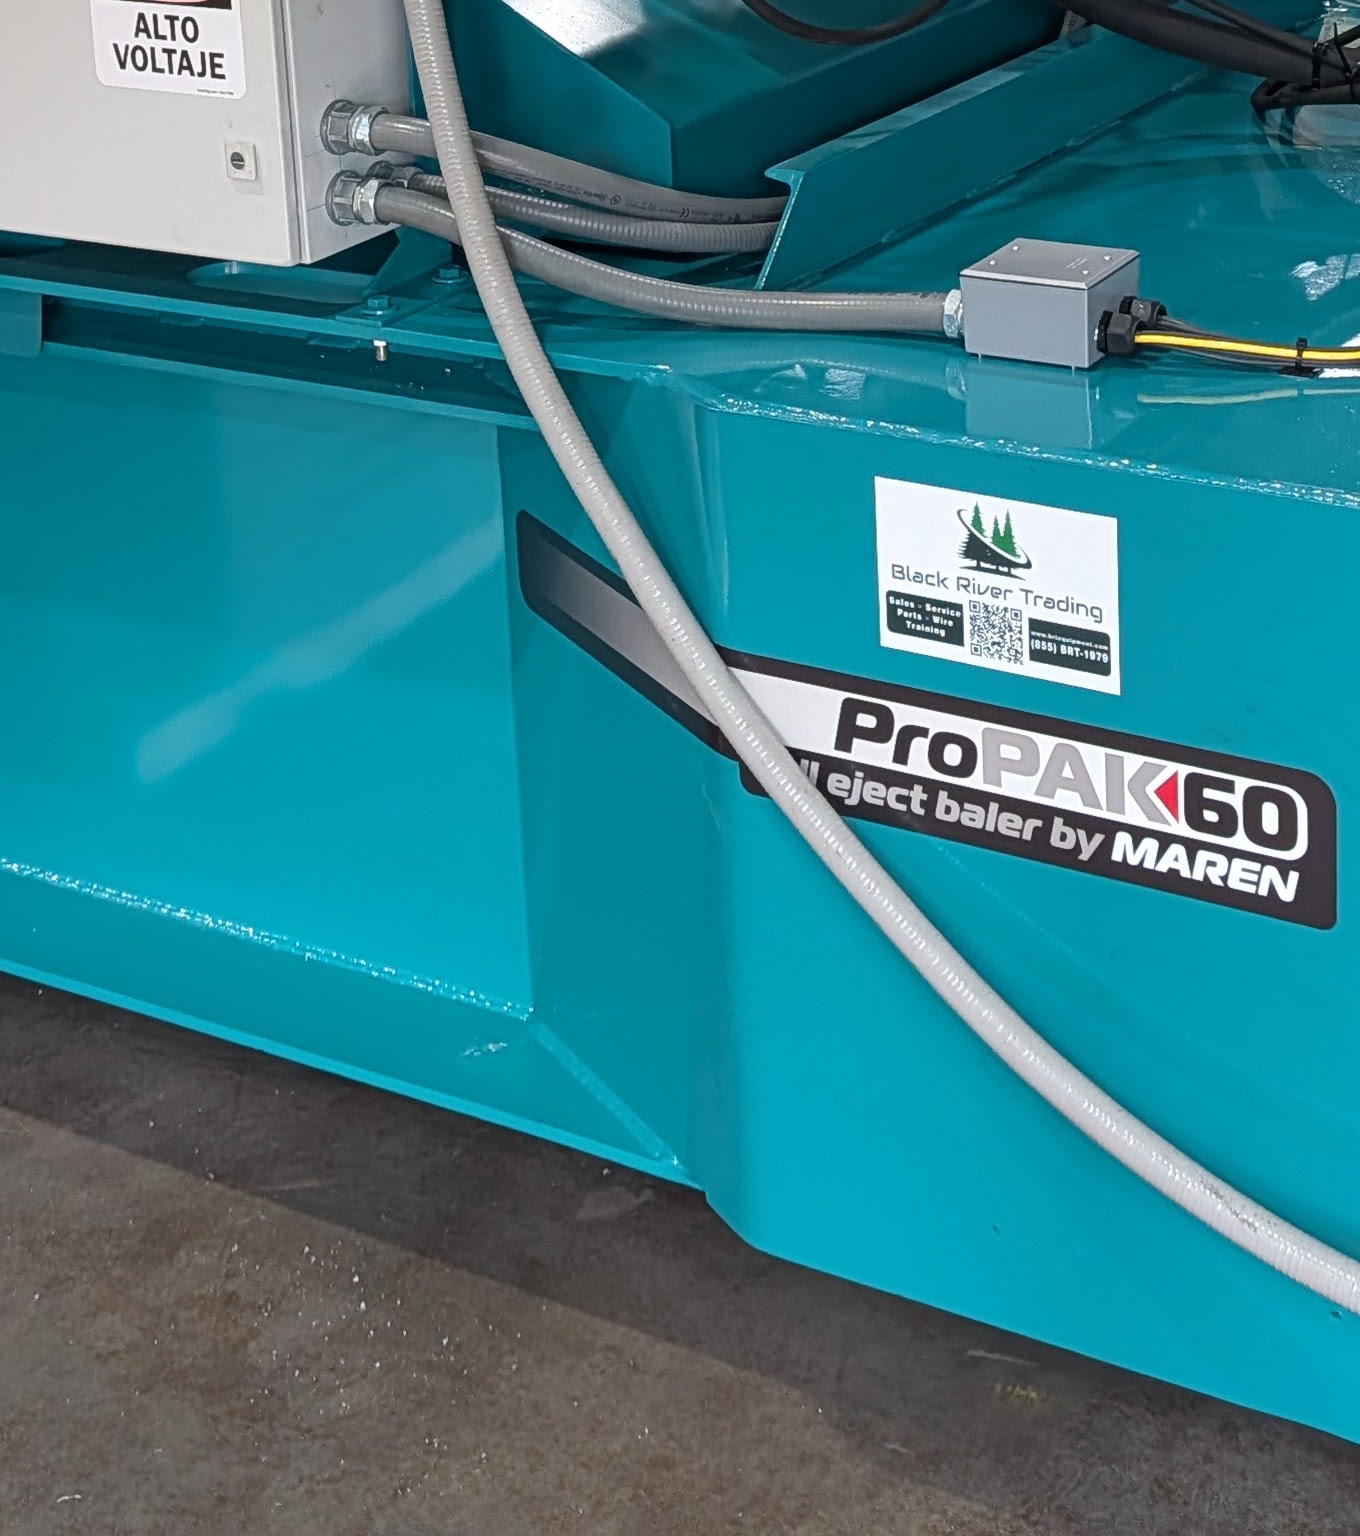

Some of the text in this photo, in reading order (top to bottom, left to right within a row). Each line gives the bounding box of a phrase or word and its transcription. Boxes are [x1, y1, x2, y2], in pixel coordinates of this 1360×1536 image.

[134, 11, 200, 44] ALTO
[113, 42, 227, 80] VOLTAJE
[888, 595, 962, 618] Sales Service
[891, 563, 1103, 624] Black River Trading
[896, 608, 954, 627] Parts Wire
[905, 620, 947, 638] Training
[1030, 638, 1109, 664] (855) BRT-1979
[827, 770, 928, 815] eject
[935, 790, 1043, 842] baler
[1049, 816, 1106, 862] by
[1110, 830, 1300, 903] MAREN
